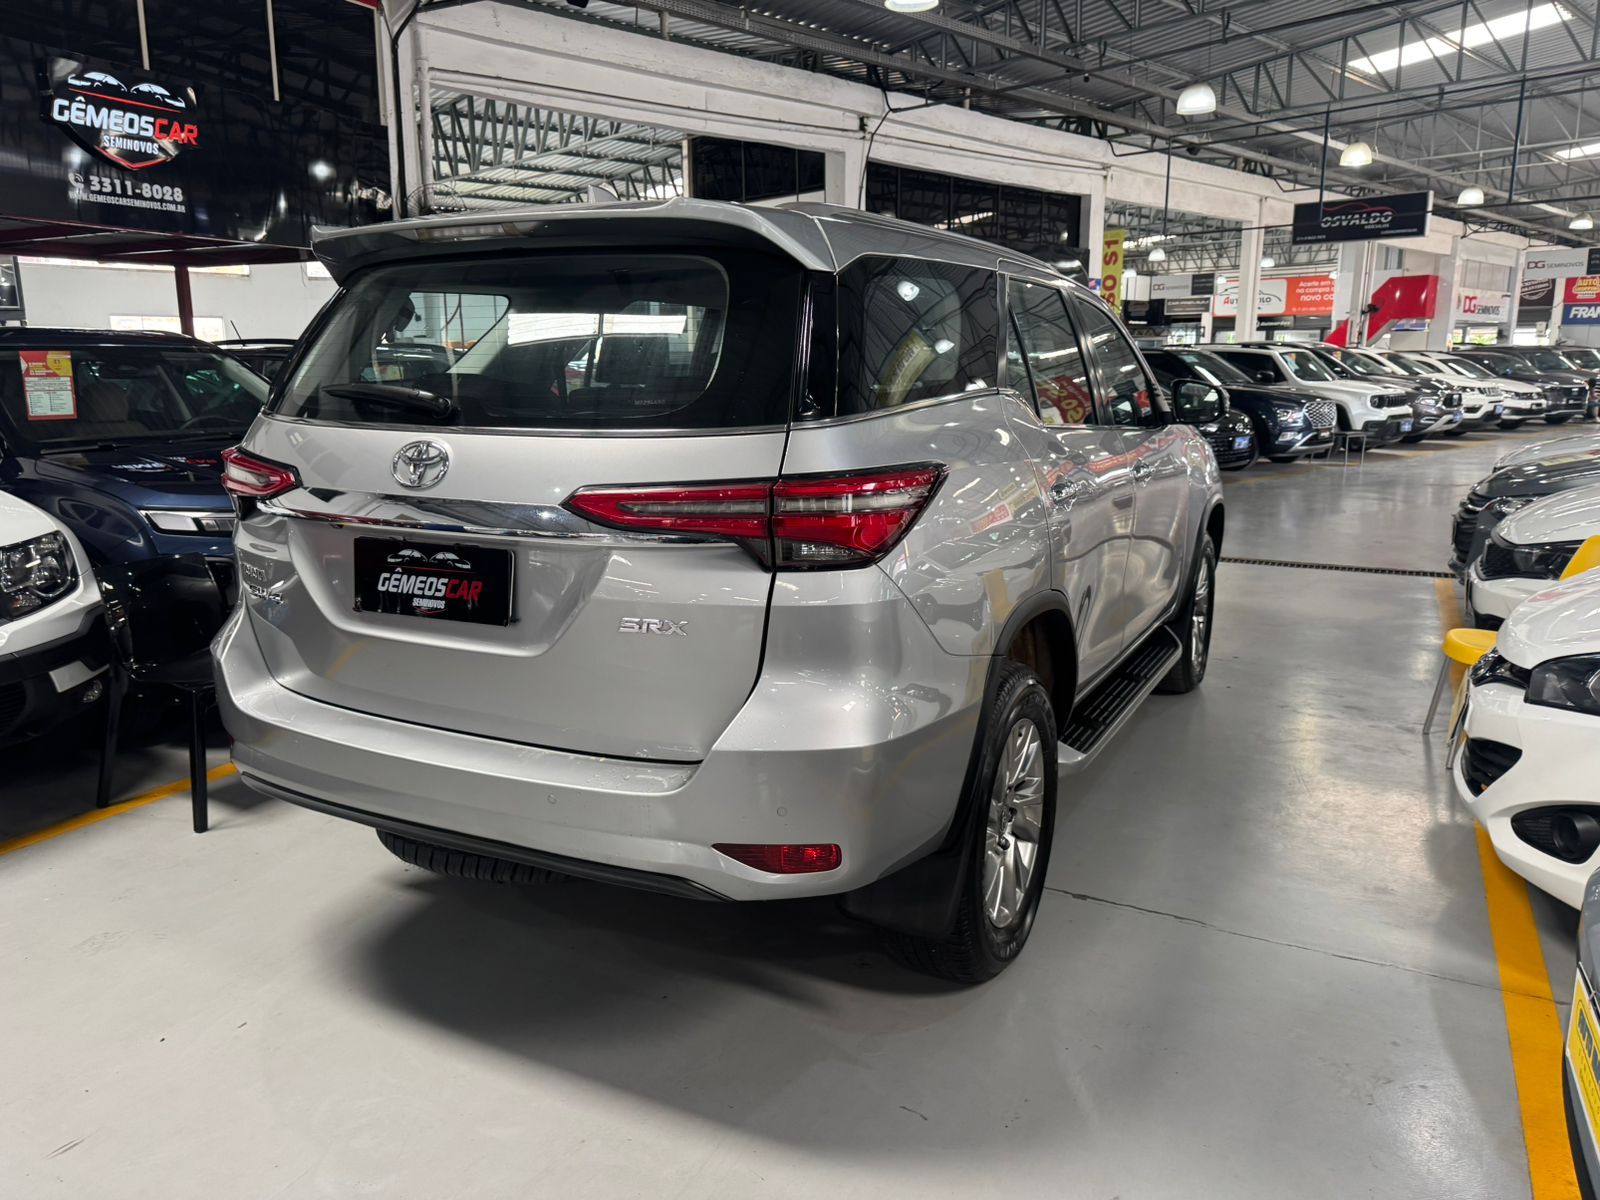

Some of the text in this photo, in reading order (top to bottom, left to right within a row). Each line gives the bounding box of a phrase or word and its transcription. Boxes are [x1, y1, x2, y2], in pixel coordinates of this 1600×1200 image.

[52, 96, 198, 145] GÊMEOSCAR
[103, 135, 159, 155] SEMINOVOS
[89, 175, 183, 202] 3311-8028
[1320, 211, 1393, 228] OSVALDO
[1527, 260, 1546, 269] DG
[1463, 295, 1477, 313] DG
[377, 567, 483, 602] GÊMEOSCAR
[412, 597, 446, 609] SEMINOVOS
[618, 617, 689, 636] SRX
